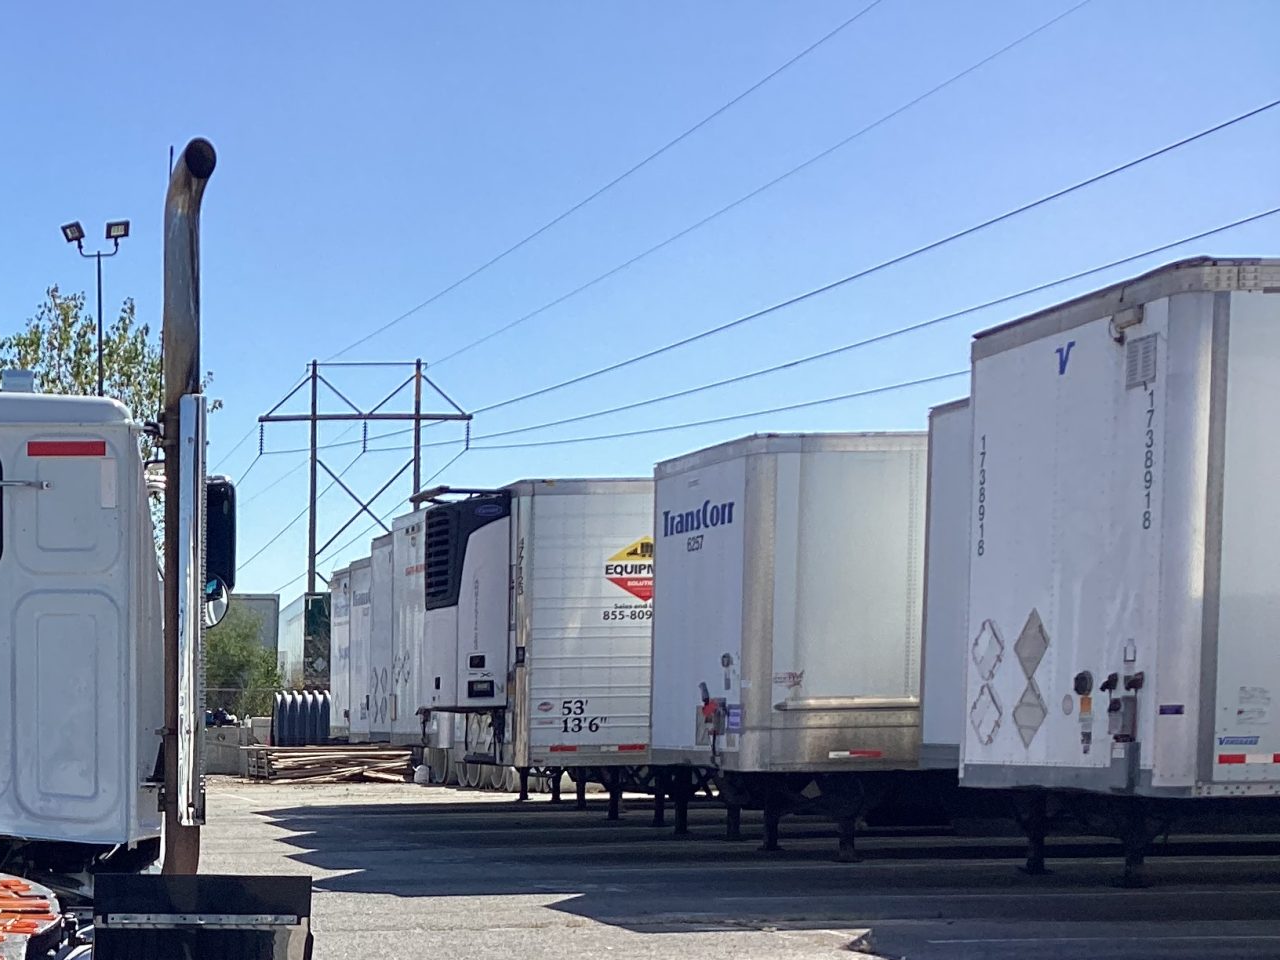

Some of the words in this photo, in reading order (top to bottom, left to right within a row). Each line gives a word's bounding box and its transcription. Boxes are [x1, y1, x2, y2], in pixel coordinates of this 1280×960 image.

[1142, 389, 1155, 530] 1738918
[977, 434, 986, 557] 1738918
[663, 499, 735, 538] TransCorr
[687, 534, 704, 552] 6257
[562, 700, 588, 716] 53'
